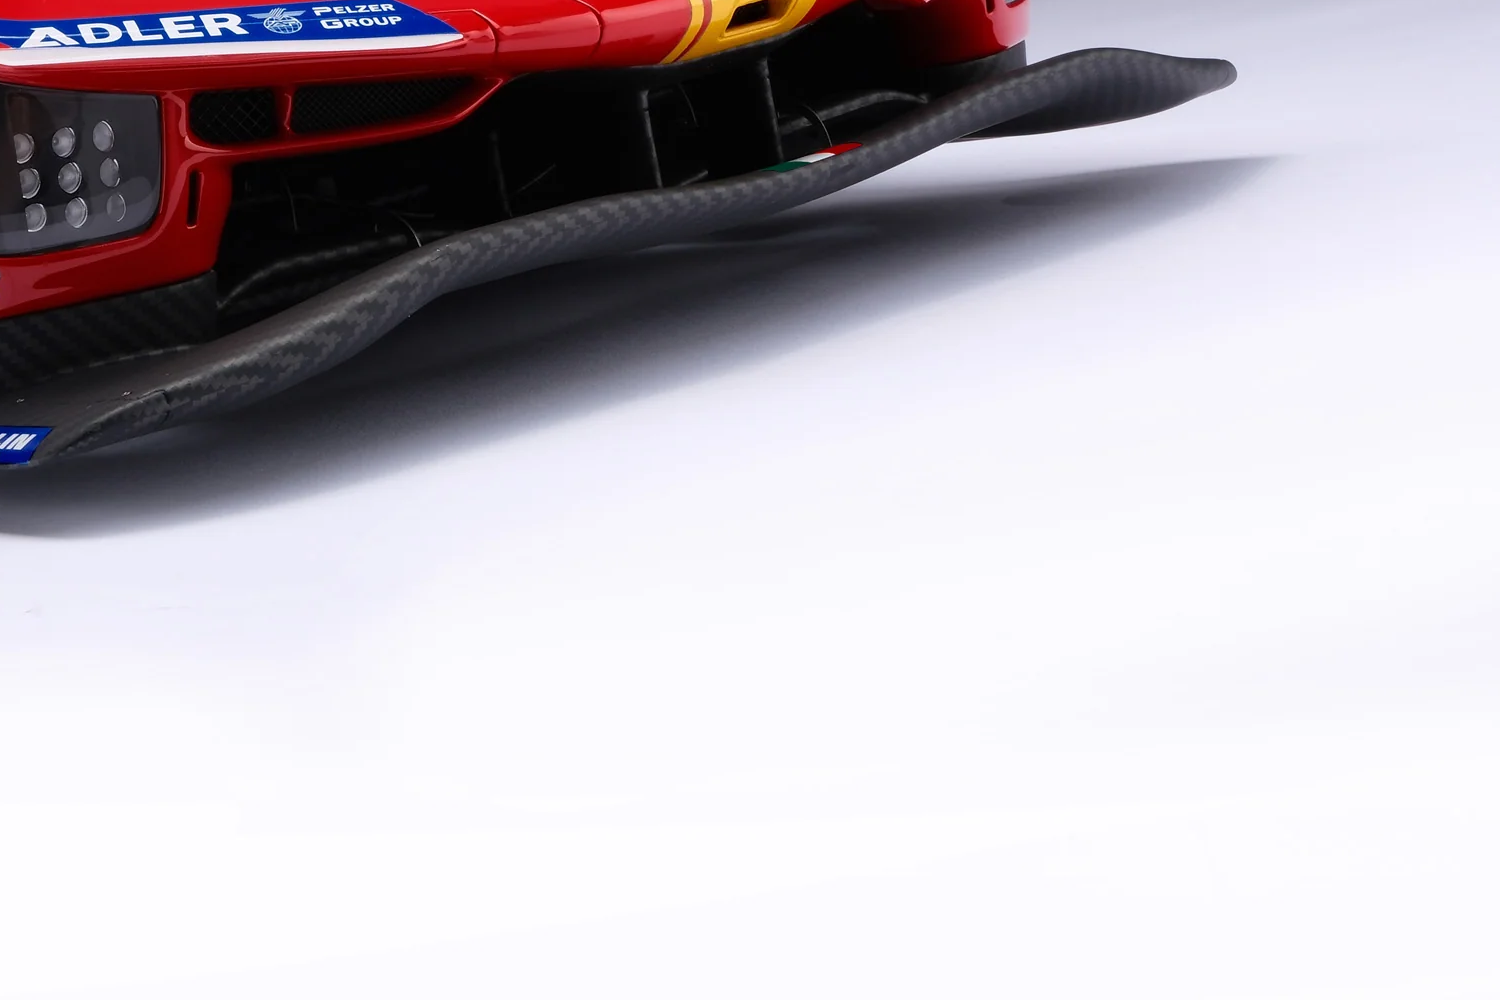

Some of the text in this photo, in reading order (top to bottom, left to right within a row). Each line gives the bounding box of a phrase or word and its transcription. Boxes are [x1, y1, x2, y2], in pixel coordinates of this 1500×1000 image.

[312, 2, 396, 17] PELZER
[319, 15, 402, 30] GROUP
[19, 12, 250, 49] ADLER
